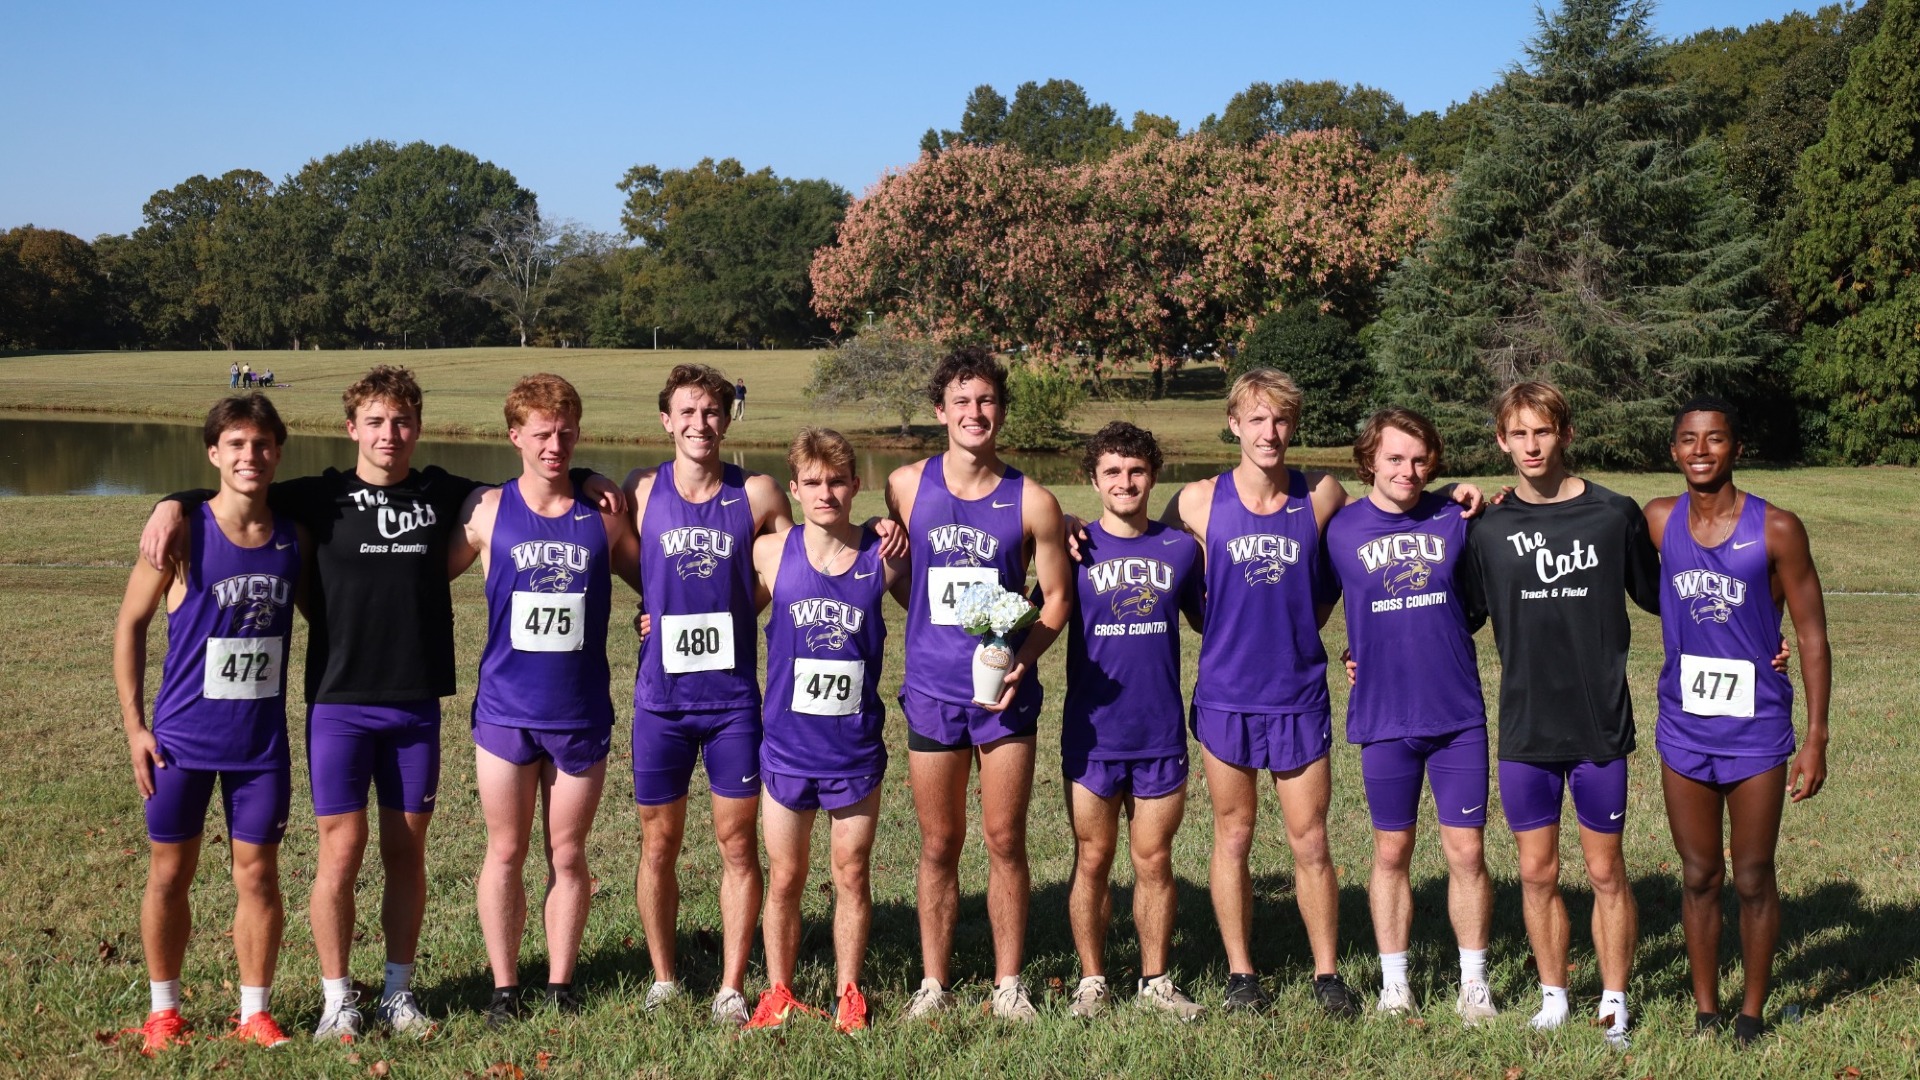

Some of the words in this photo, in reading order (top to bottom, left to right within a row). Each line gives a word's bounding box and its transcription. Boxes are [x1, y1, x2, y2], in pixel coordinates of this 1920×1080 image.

[349, 488, 389, 511] The
[377, 500, 437, 538] Cats
[359, 543, 388, 554] Cross
[391, 543, 428, 555] Country
[511, 541, 590, 573] WCU
[660, 527, 734, 559] WCU
[928, 524, 999, 561] WCU
[1226, 534, 1300, 565] WCU
[1357, 533, 1445, 574] WCU
[1507, 531, 1546, 557] The
[1088, 558, 1174, 595] WCU
[1535, 540, 1599, 583] Cats
[212, 574, 291, 610] WCU
[1371, 599, 1403, 613] CROSS
[1406, 592, 1447, 609] COUNTRY
[1521, 588, 1549, 600] Track
[1562, 587, 1588, 598] Field
[1673, 569, 1746, 606] WCU
[525, 608, 571, 635] 475
[790, 598, 864, 633] WCU
[1094, 623, 1125, 636] CROSS
[1129, 621, 1168, 635] COUNTRY
[676, 627, 720, 656] 480
[221, 652, 270, 682] 472
[806, 674, 852, 701] 479
[1692, 671, 1739, 701] 477
